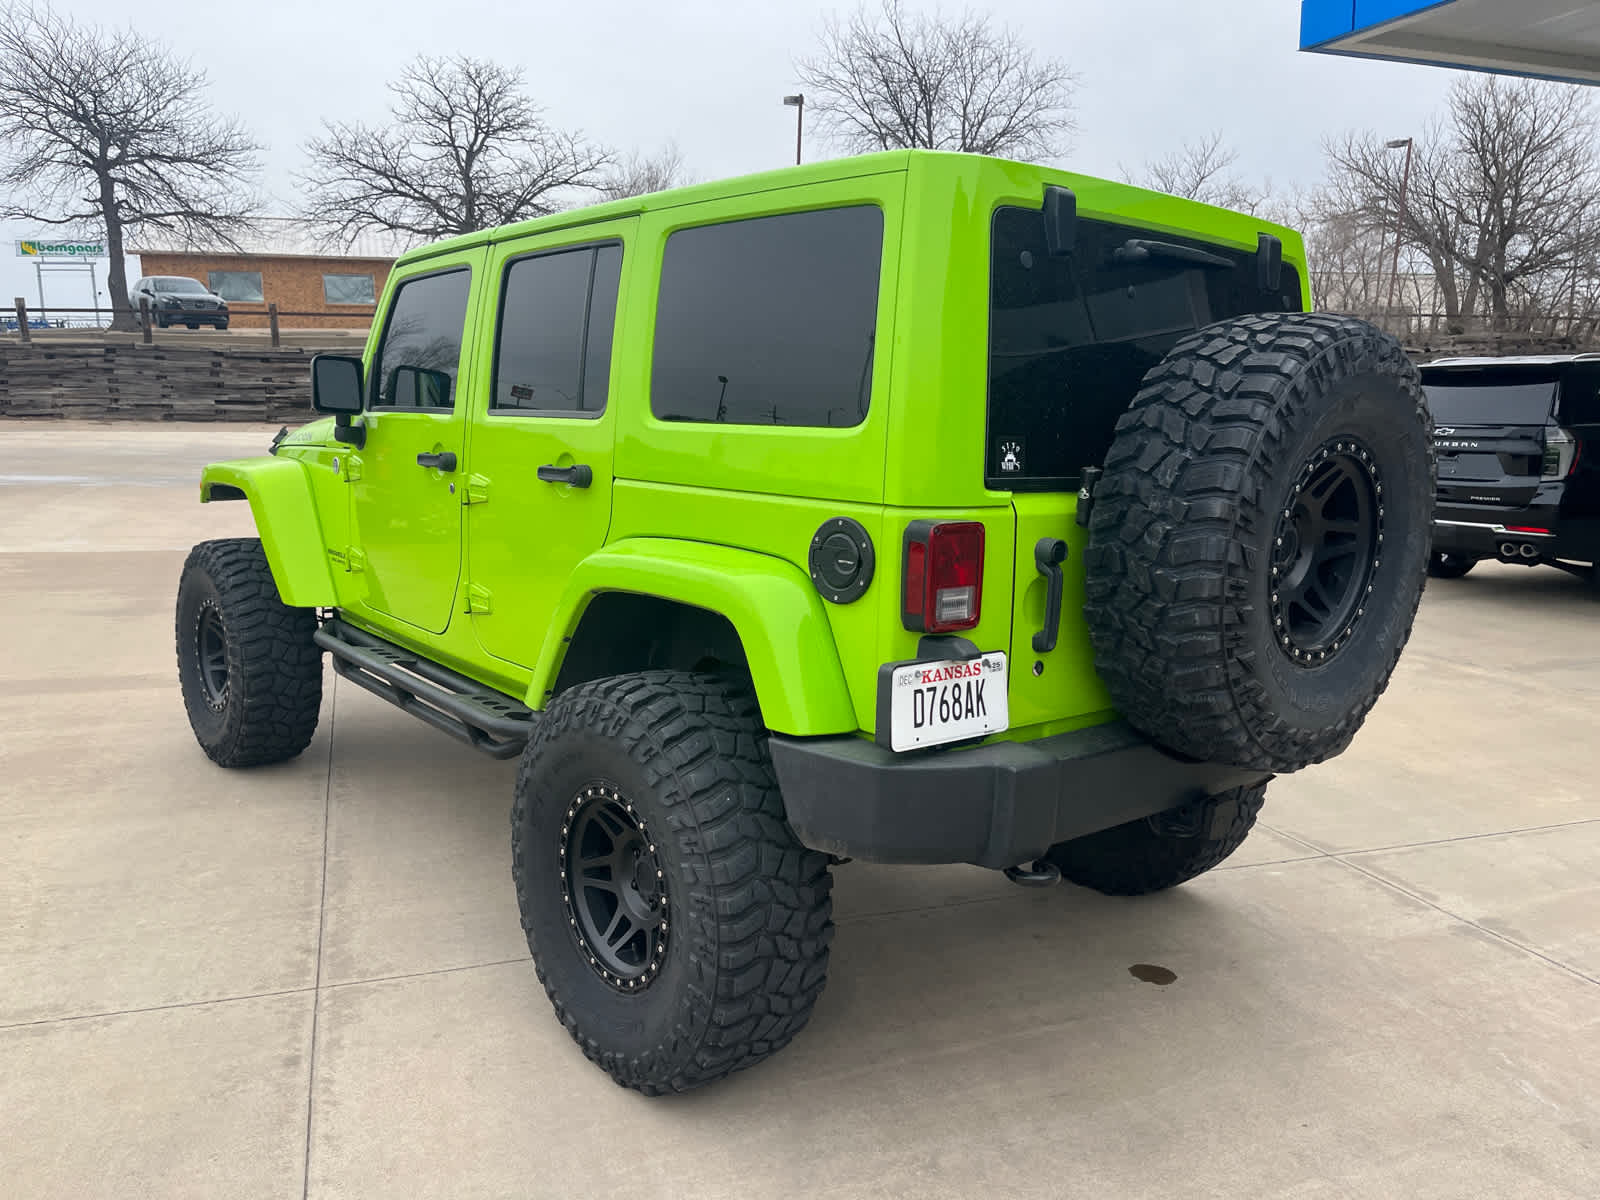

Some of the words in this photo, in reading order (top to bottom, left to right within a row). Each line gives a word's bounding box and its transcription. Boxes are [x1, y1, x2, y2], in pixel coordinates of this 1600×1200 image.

[38, 241, 104, 255] bomgaars
[921, 662, 982, 684] KANSAS
[913, 678, 987, 728] D768AK
